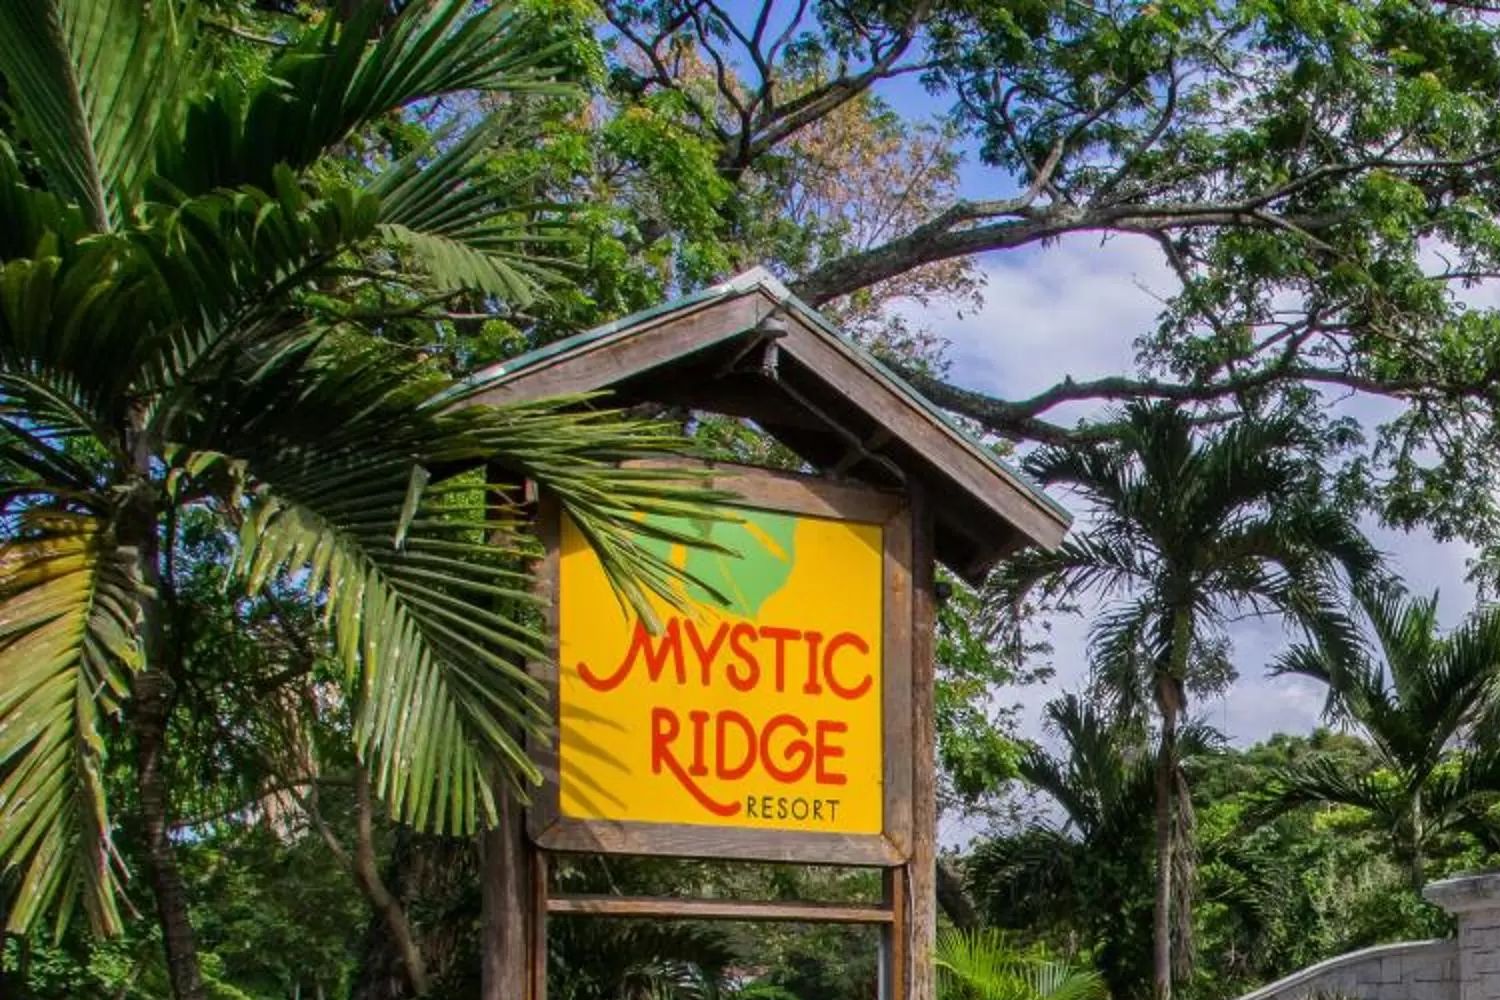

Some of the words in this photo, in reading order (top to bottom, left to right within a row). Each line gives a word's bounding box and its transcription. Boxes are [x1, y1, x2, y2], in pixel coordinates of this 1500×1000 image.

[576, 617, 873, 700] MYSTIC
[651, 706, 848, 817] RIDGE
[746, 795, 840, 822] RESORT
